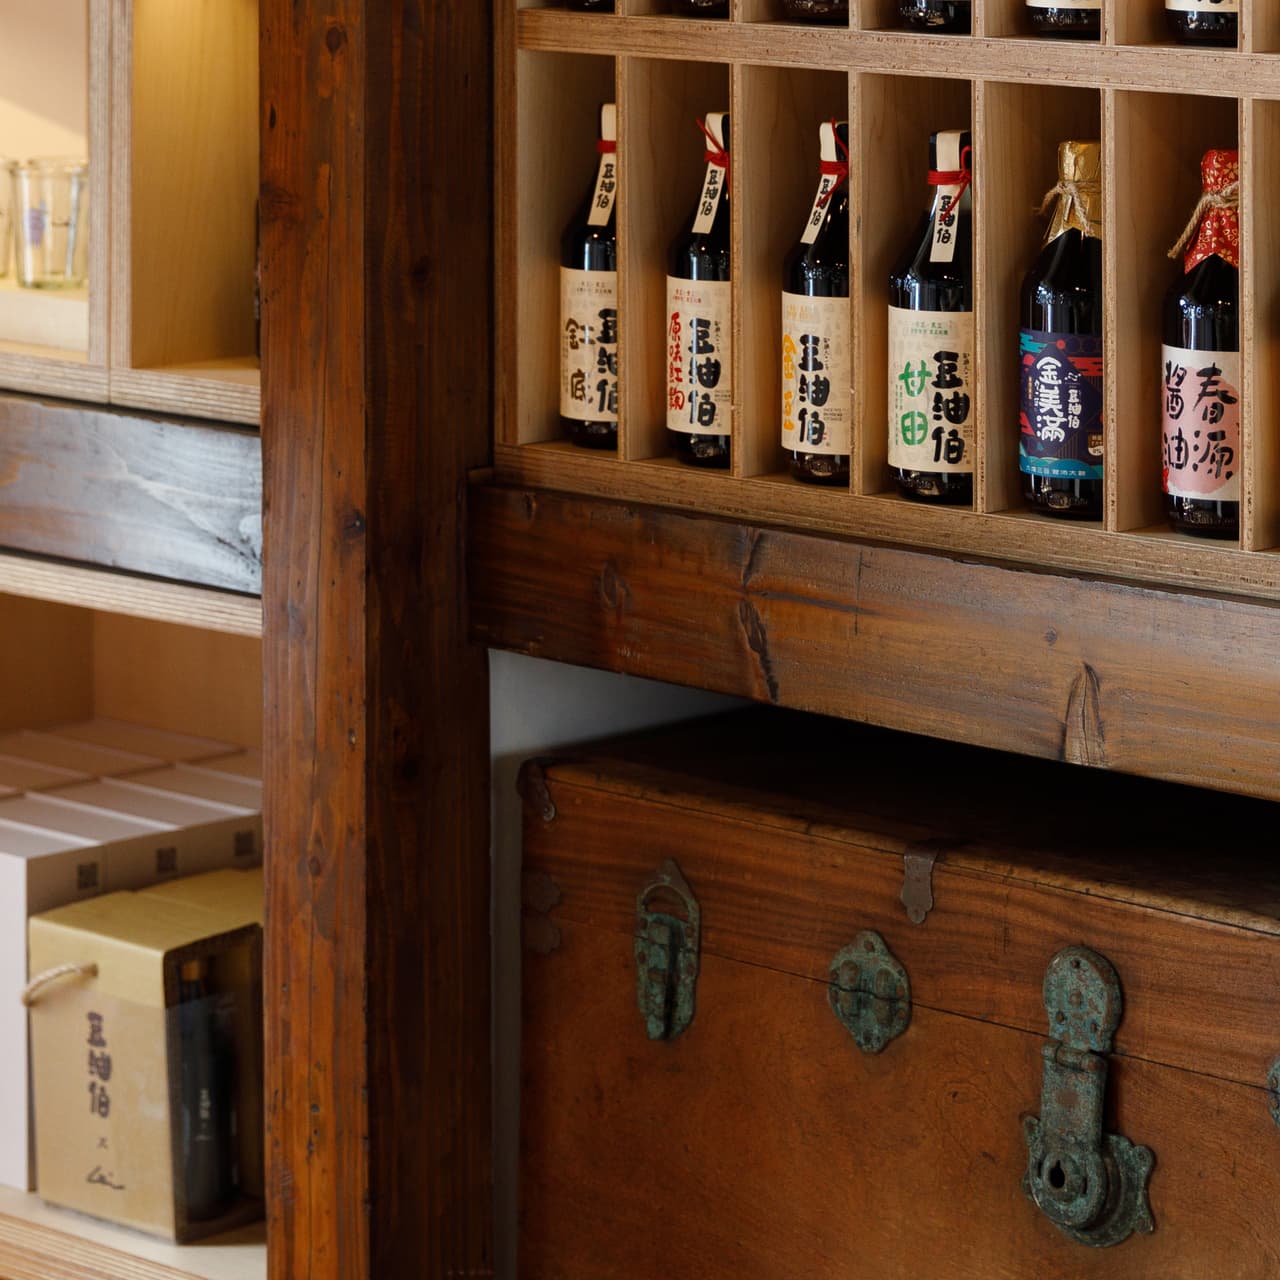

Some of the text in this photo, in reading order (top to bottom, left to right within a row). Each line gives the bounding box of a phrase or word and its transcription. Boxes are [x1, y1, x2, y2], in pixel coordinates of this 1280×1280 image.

[596, 163, 616, 209] 豆油伯
[701, 169, 718, 216] 豆油伯
[688, 317, 721, 427] 豆油伯
[798, 333, 830, 446] 豆油伯
[932, 350, 970, 465] 豆油伯
[1068, 389, 1082, 429] 豆油伯
[1192, 362, 1237, 480] 春源
